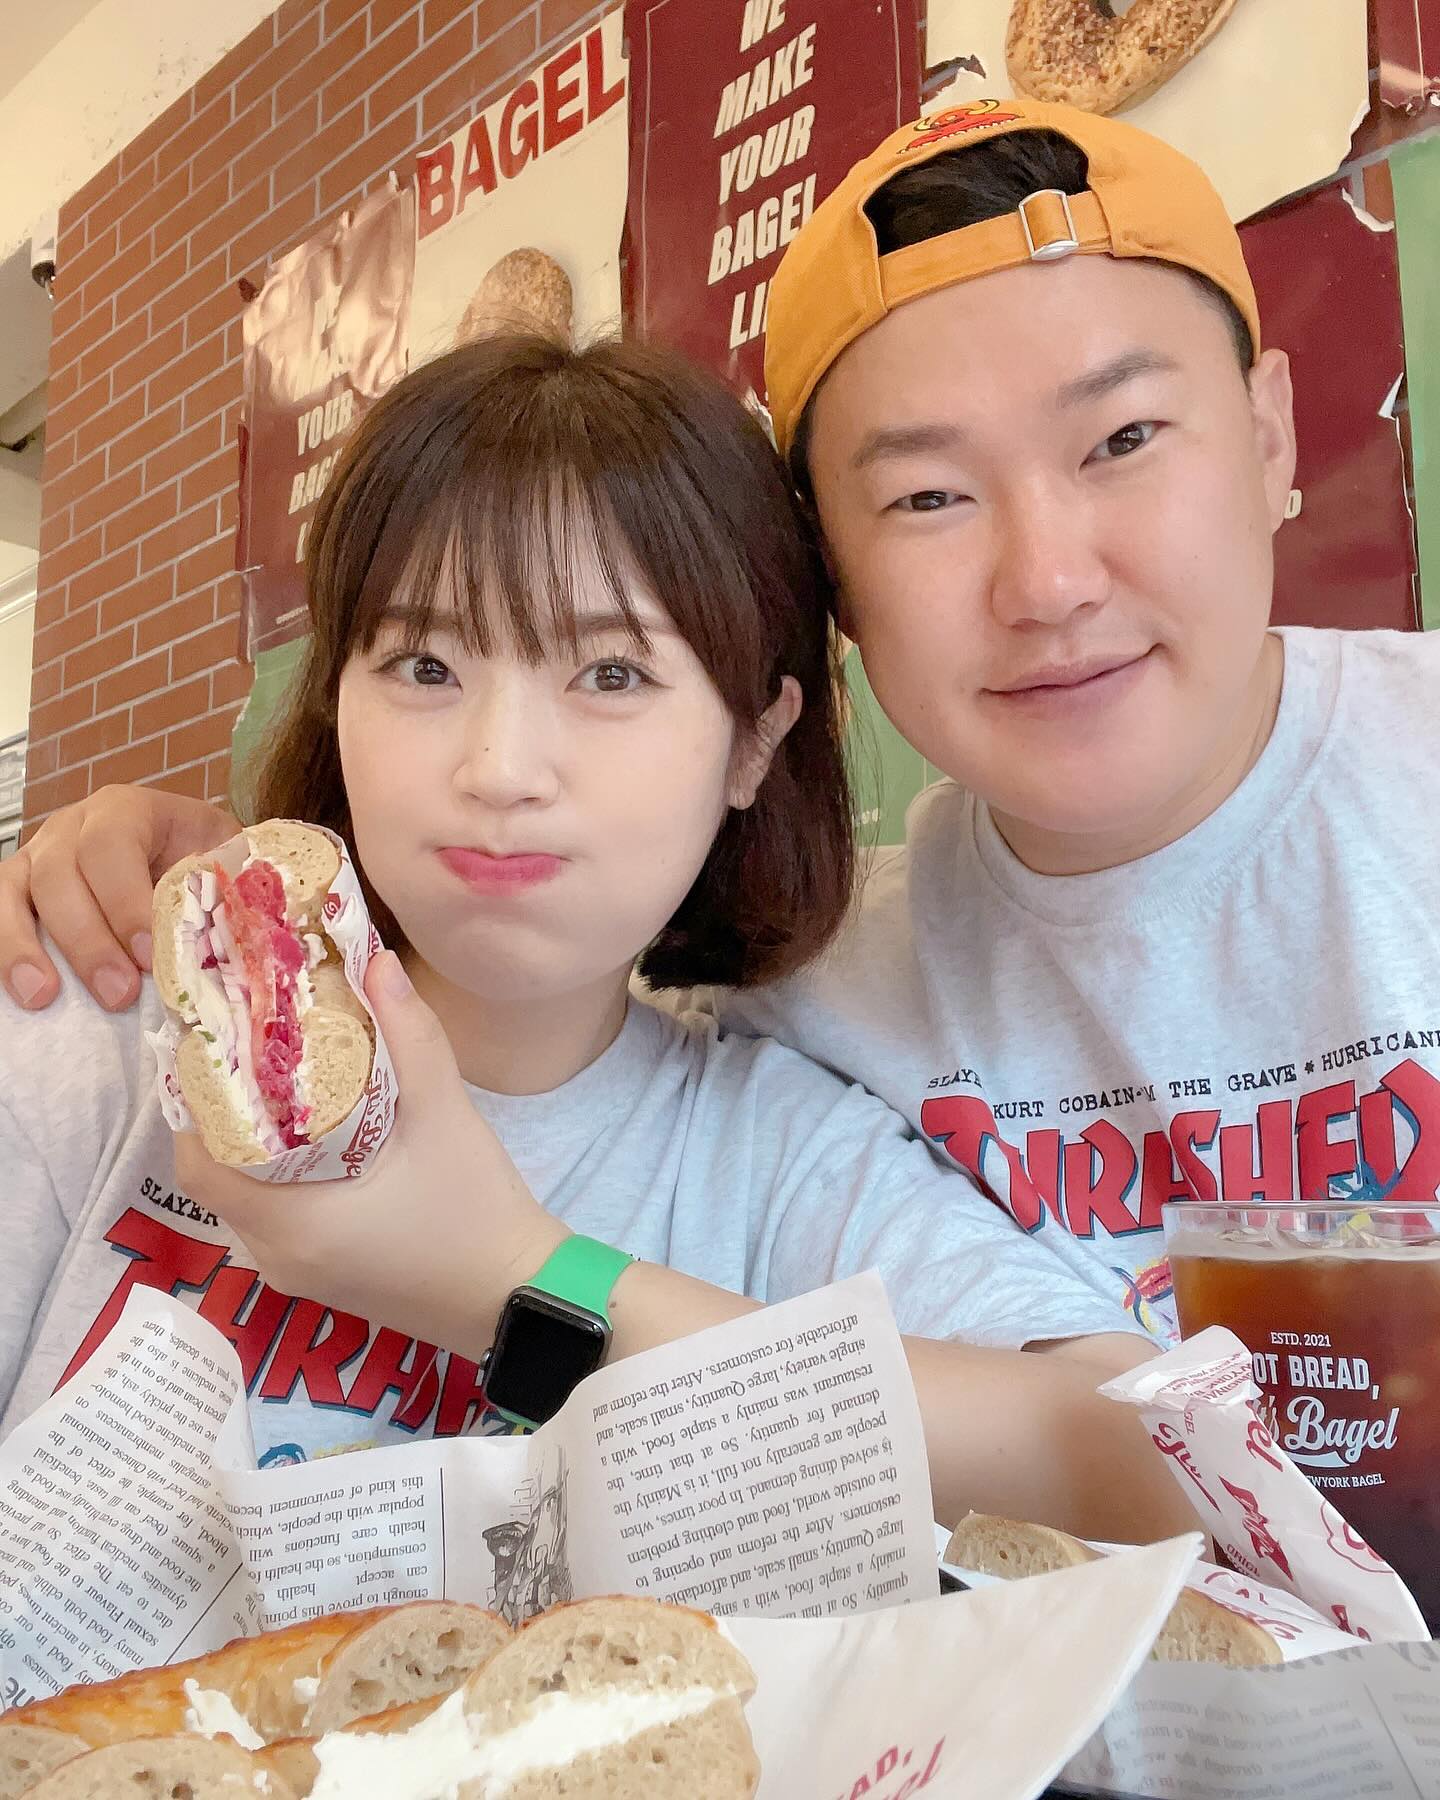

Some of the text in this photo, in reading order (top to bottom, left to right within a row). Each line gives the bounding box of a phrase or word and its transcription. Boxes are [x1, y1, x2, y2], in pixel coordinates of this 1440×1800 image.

[713, 22, 817, 139] MAKE
[416, 27, 627, 241] BAGEL
[719, 104, 815, 206] YOUR
[297, 388, 353, 456] YOUR
[1168, 1078, 1212, 1098] THE
[1228, 1063, 1297, 1092] GRAVE
[993, 1101, 1045, 1119] KURT
[1059, 1086, 1135, 1114] COBAIN
[794, 1314, 858, 1347] affordable
[1270, 1331, 1332, 1348] ESTD. 2021
[775, 1337, 794, 1353] for
[828, 1338, 866, 1362] single
[670, 1368, 702, 1391] After
[746, 1369, 780, 1388] large
[812, 1363, 873, 1394] restaurant
[1252, 1352, 1279, 1386] OT
[1288, 1354, 1381, 1400] BREAD,
[648, 1381, 670, 1398] the
[783, 1386, 809, 1403] was
[608, 1389, 648, 1411] reform
[736, 1395, 779, 1421] mainly
[831, 1388, 880, 1418] demand
[592, 1403, 609, 1423] and
[649, 1402, 684, 1427] small
[720, 1412, 730, 1424] a
[806, 1407, 825, 1423] for
[679, 1417, 717, 1441] staple
[845, 1409, 887, 1439] people
[1284, 1395, 1400, 1463] Bagel
[595, 1427, 614, 1446] and
[720, 1436, 739, 1452] So
[823, 1428, 843, 1444] are
[881, 1436, 893, 1456] is
[610, 1446, 638, 1466] with
[699, 1445, 714, 1460] at
[766, 1432, 820, 1465] generally
[839, 1443, 879, 1471] solved
[600, 1455, 607, 1466] a
[668, 1452, 694, 1471] that
[740, 1455, 762, 1473] not
[798, 1458, 838, 1480] dining
[606, 1476, 625, 1492] the
[697, 1473, 710, 1488] it
[878, 1466, 897, 1483] the
[1351, 1473, 1386, 1489] BAGEL
[269, 1475, 423, 1515] this kind of environment
[636, 1479, 683, 1509] Mainly
[683, 1478, 697, 1493] is
[832, 1473, 876, 1499] outside
[377, 1494, 424, 1515] popular
[697, 1490, 727, 1514] poor
[727, 1488, 744, 1504] In
[322, 1510, 345, 1524] the
[346, 1505, 374, 1521] with
[613, 1500, 632, 1516] the
[760, 1501, 791, 1524] food
[619, 1520, 654, 1539] when
[736, 1511, 760, 1531] and
[805, 1514, 834, 1535] After
[875, 1519, 904, 1539] large
[235, 1526, 273, 1540] which
[249, 1519, 425, 1562] health care functions will
[681, 1519, 734, 1545] clothing
[781, 1526, 800, 1543] the
[626, 1533, 681, 1564] problem
[736, 1533, 777, 1555] reform
[304, 1558, 324, 1572] the
[326, 1555, 341, 1566] so
[651, 1553, 705, 1582] opening
[709, 1547, 733, 1568] and
[787, 1547, 819, 1572] small
[868, 1546, 906, 1573] mainly
[264, 1561, 302, 1582] health
[818, 1565, 851, 1589] staple
[856, 1562, 863, 1574] a
[276, 1565, 428, 1602] can accept health
[635, 1575, 649, 1588] to
[728, 1569, 752, 1589] and
[327, 1593, 363, 1612] prove
[364, 1592, 379, 1610] to
[382, 1587, 428, 1608] enough
[742, 1597, 750, 1609] a
[754, 1589, 780, 1609] with
[301, 1604, 324, 1620] this
